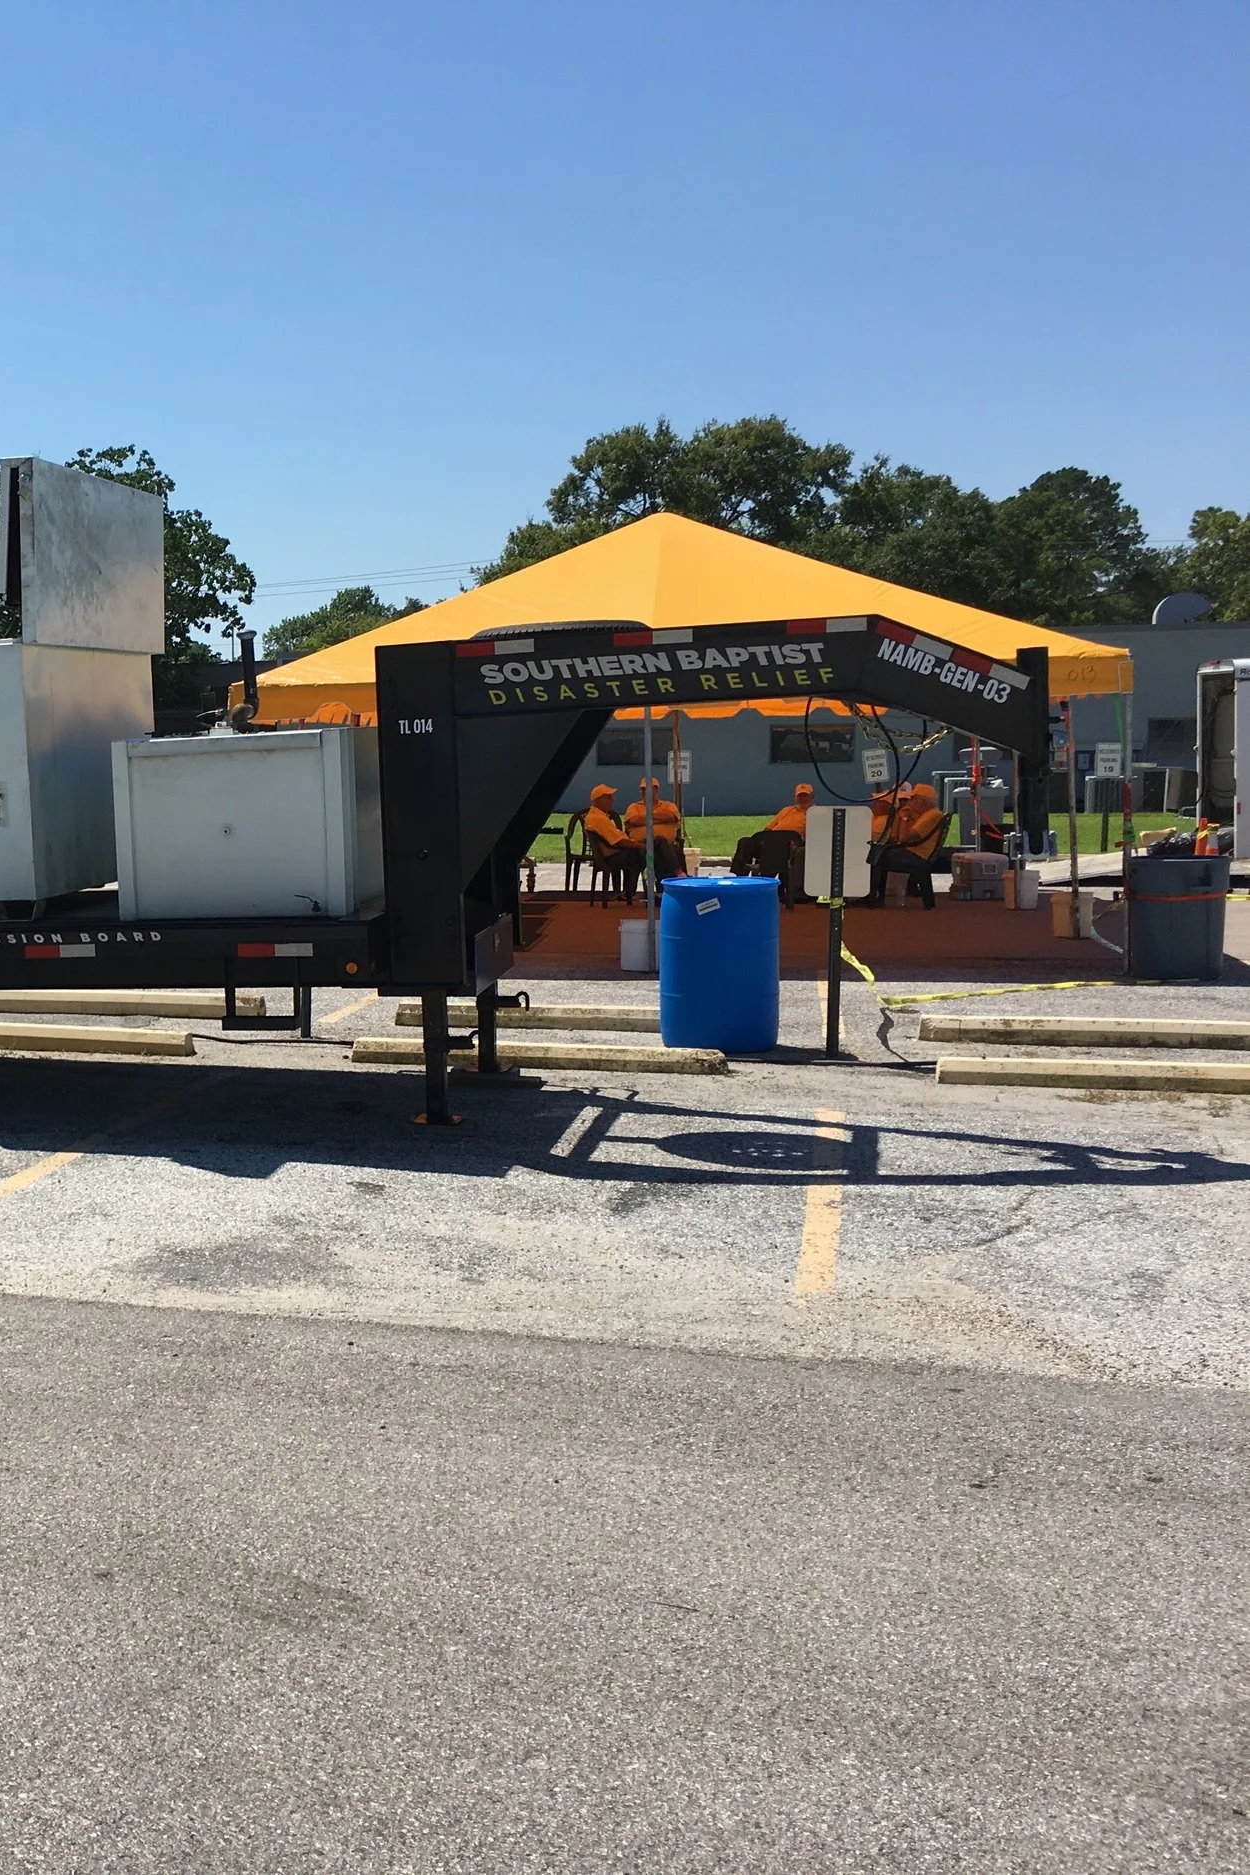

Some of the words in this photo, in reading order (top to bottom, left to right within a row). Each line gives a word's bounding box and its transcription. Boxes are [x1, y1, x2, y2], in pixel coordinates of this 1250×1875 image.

[480, 651, 673, 684] SOUTHERN
[675, 642, 825, 671] BAPTIST
[877, 638, 1011, 704] NAMB-GEN-03
[488, 672, 676, 705] DISASTER
[700, 667, 835, 691] RELIEF
[398, 719, 411, 734] TL
[413, 718, 434, 734] 014
[870, 769, 883, 778] 20
[1103, 765, 1114, 773] 19
[79, 931, 162, 942] BOARD
